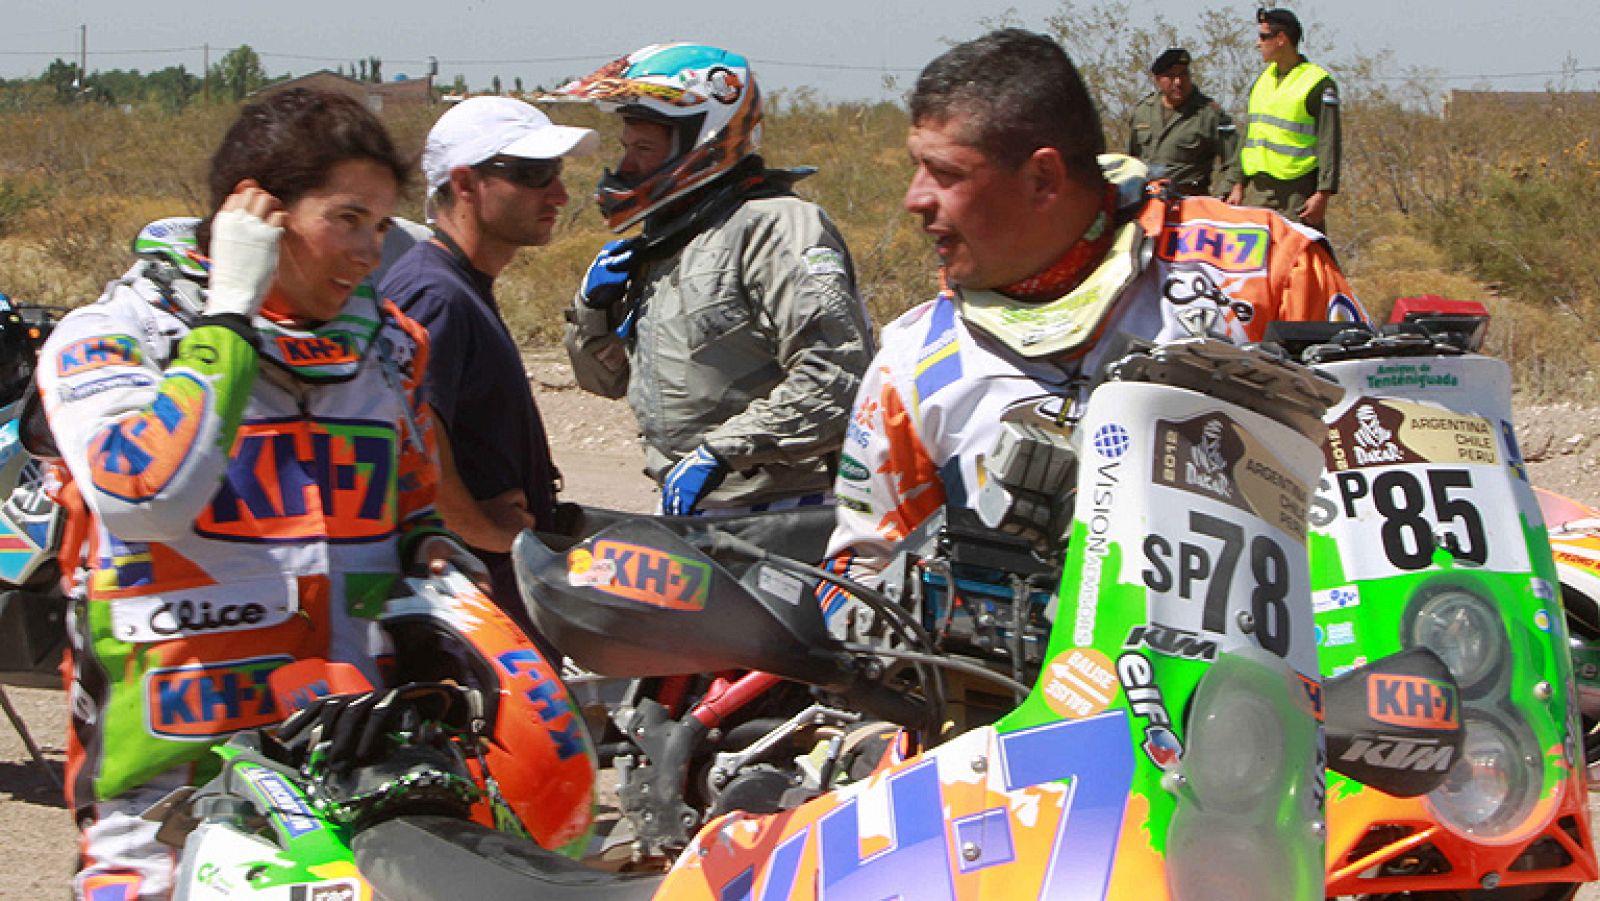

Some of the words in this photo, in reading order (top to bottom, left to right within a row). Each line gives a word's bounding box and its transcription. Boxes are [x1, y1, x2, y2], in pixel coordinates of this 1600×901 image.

[1167, 229, 1258, 263] KH-7
[1411, 418, 1490, 434] ARGENTINA
[1456, 433, 1492, 449] CHILE
[1458, 448, 1496, 463] PERU
[212, 434, 395, 523] KH-7
[1087, 461, 1121, 554] VISION
[604, 548, 707, 603] KH-7
[150, 602, 268, 635] Clice
[1127, 621, 1219, 660] KTM
[1117, 650, 1172, 728] elf
[1340, 735, 1455, 771] KTM
